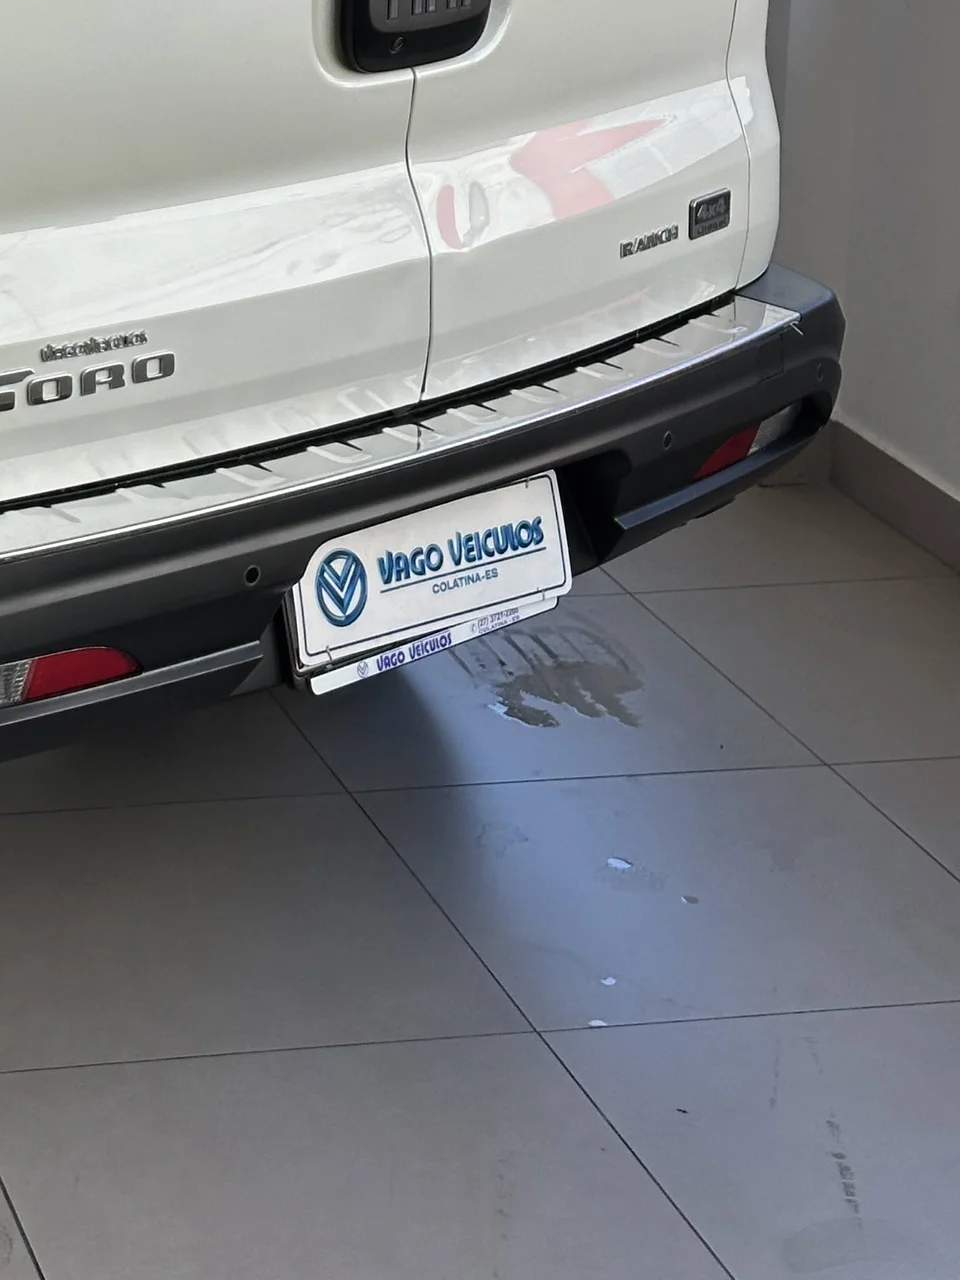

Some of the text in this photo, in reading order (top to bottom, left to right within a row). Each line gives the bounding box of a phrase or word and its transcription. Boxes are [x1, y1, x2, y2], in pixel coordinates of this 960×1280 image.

[620, 222, 679, 258] RANCH
[376, 516, 545, 585] VAGO VEICULOS
[432, 567, 499, 595] COLATINA-ES
[376, 631, 452, 671] VAGO VEICULOS
